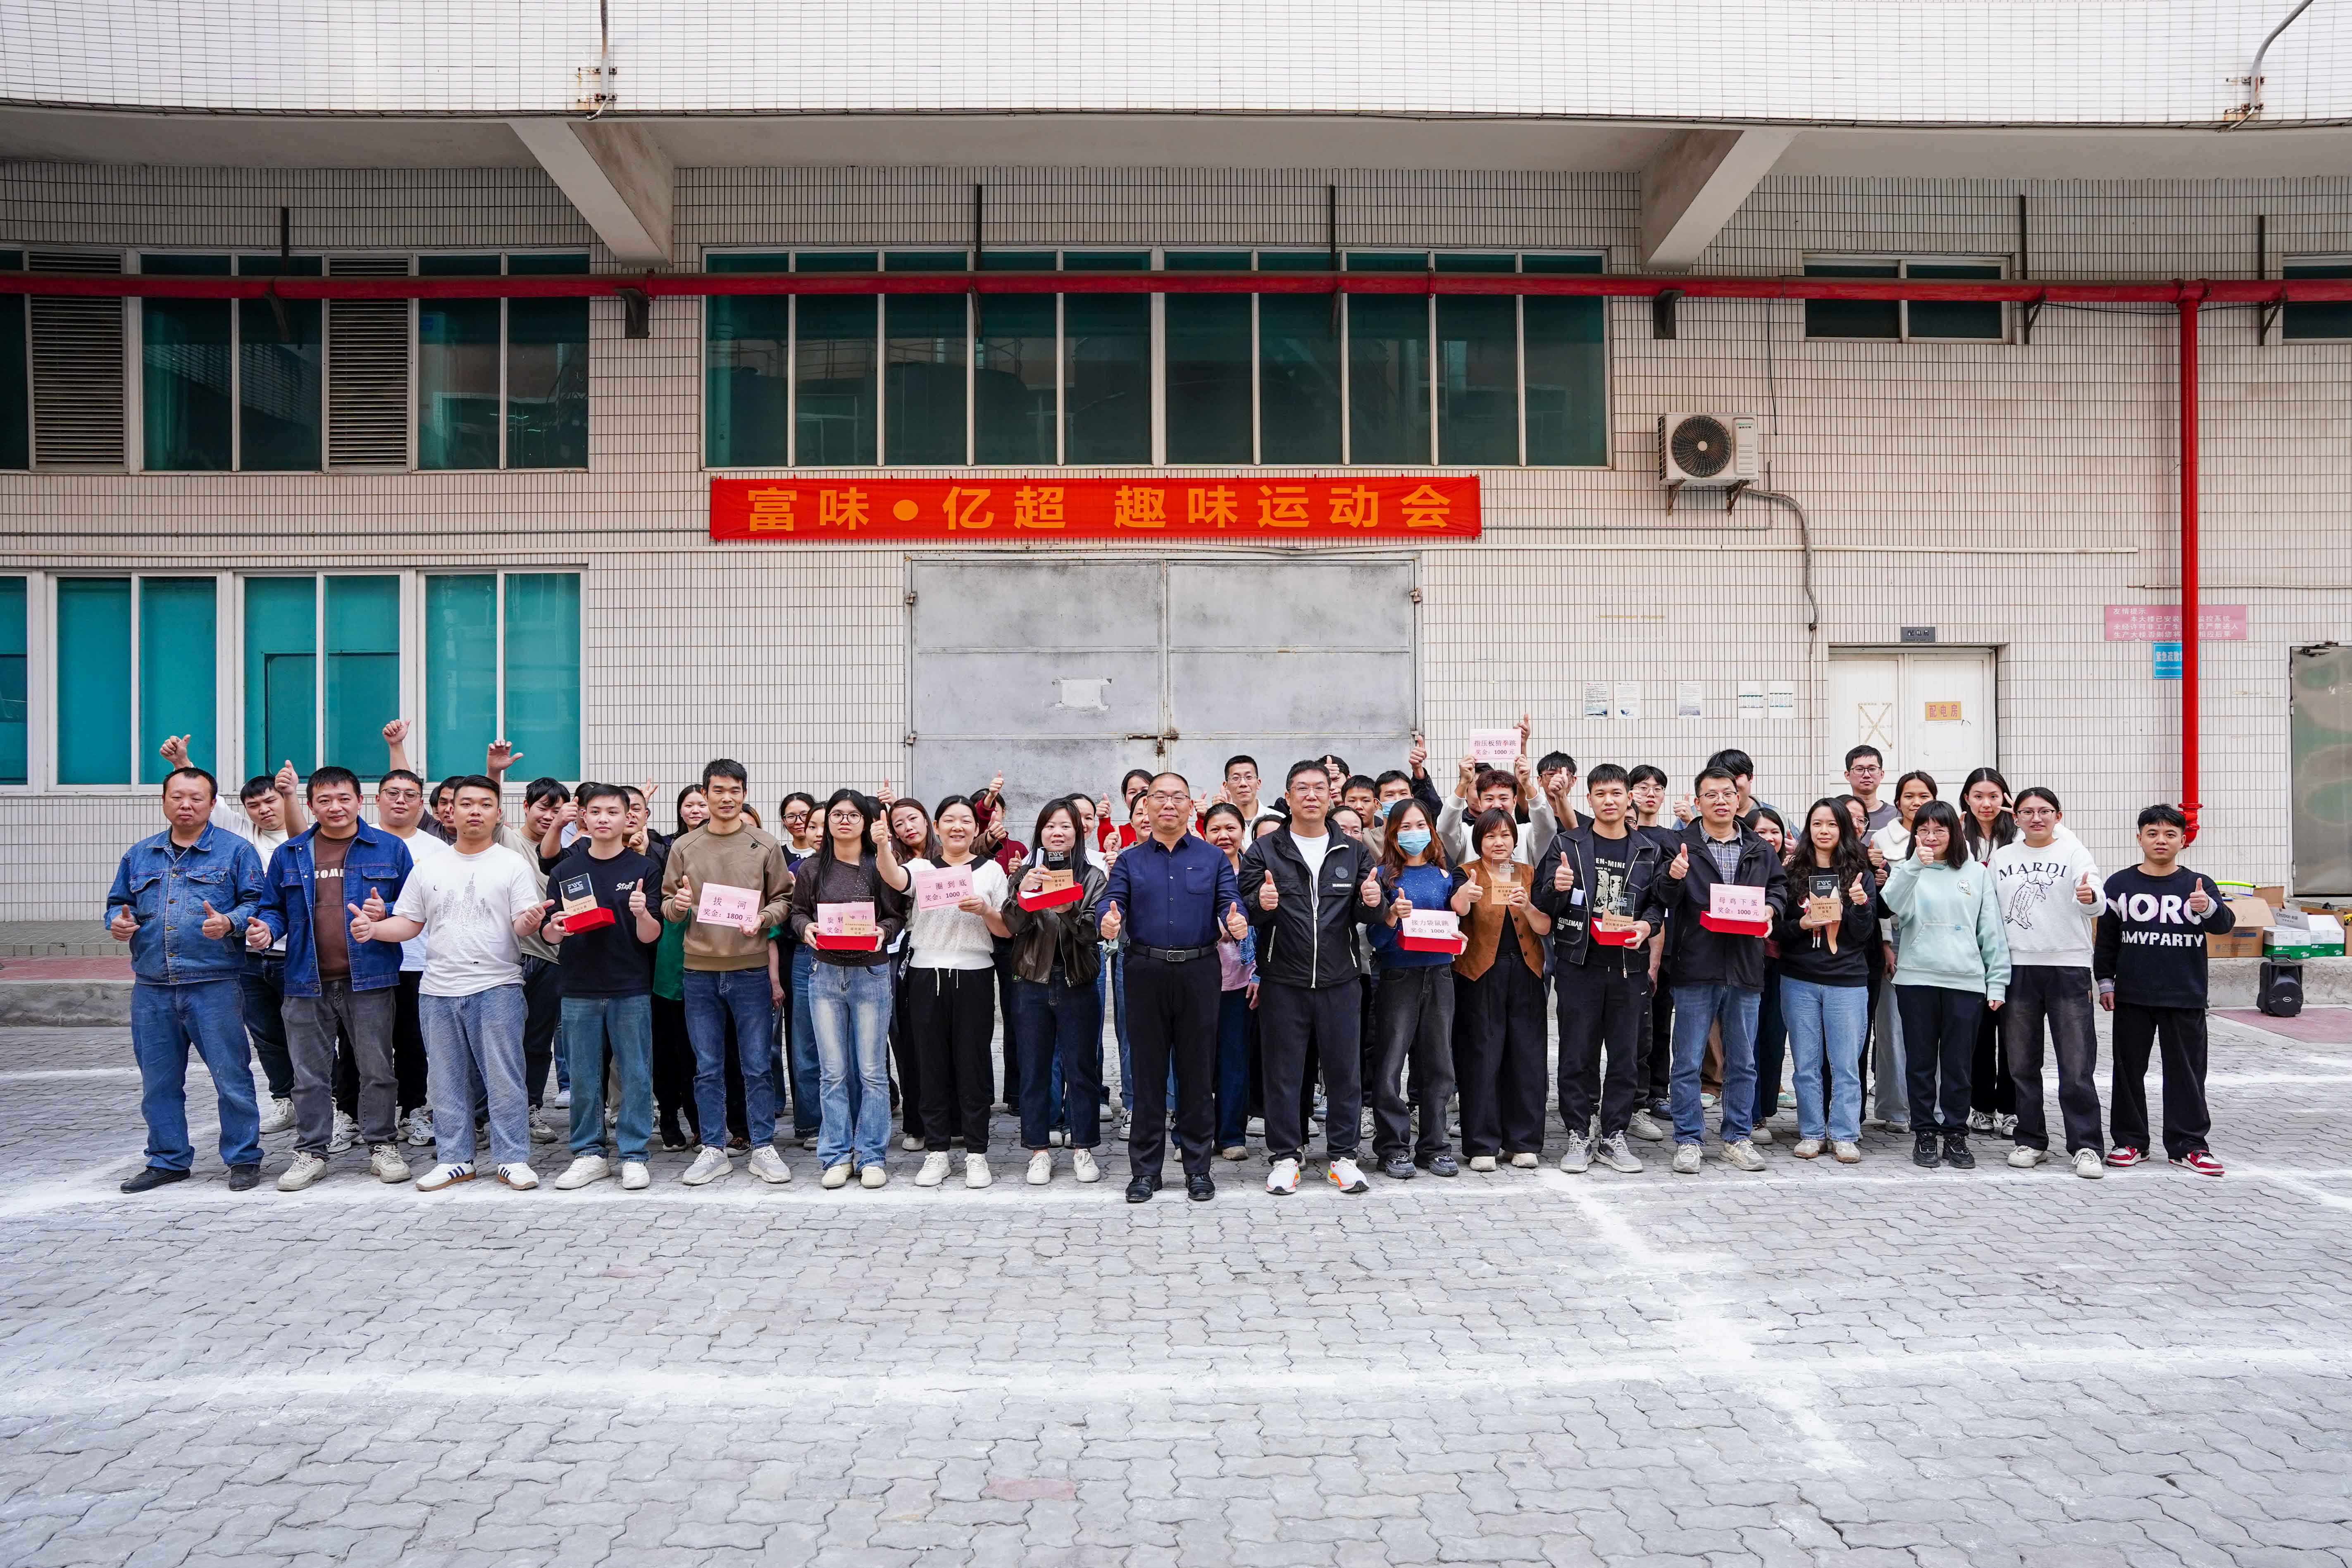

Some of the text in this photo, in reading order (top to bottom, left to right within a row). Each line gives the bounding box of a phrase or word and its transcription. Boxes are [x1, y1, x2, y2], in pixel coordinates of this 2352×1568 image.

[1114, 484, 1451, 528] 趣味运动会
[2156, 651, 2182, 661] 紧急疏散
[1929, 704, 1958, 718] 配电房
[1998, 862, 2067, 881] MARDI
[922, 879, 967, 890] 一圈到底
[1719, 897, 1758, 906] 母鸡下蛋
[1558, 917, 1583, 928] GENTLEMAN
